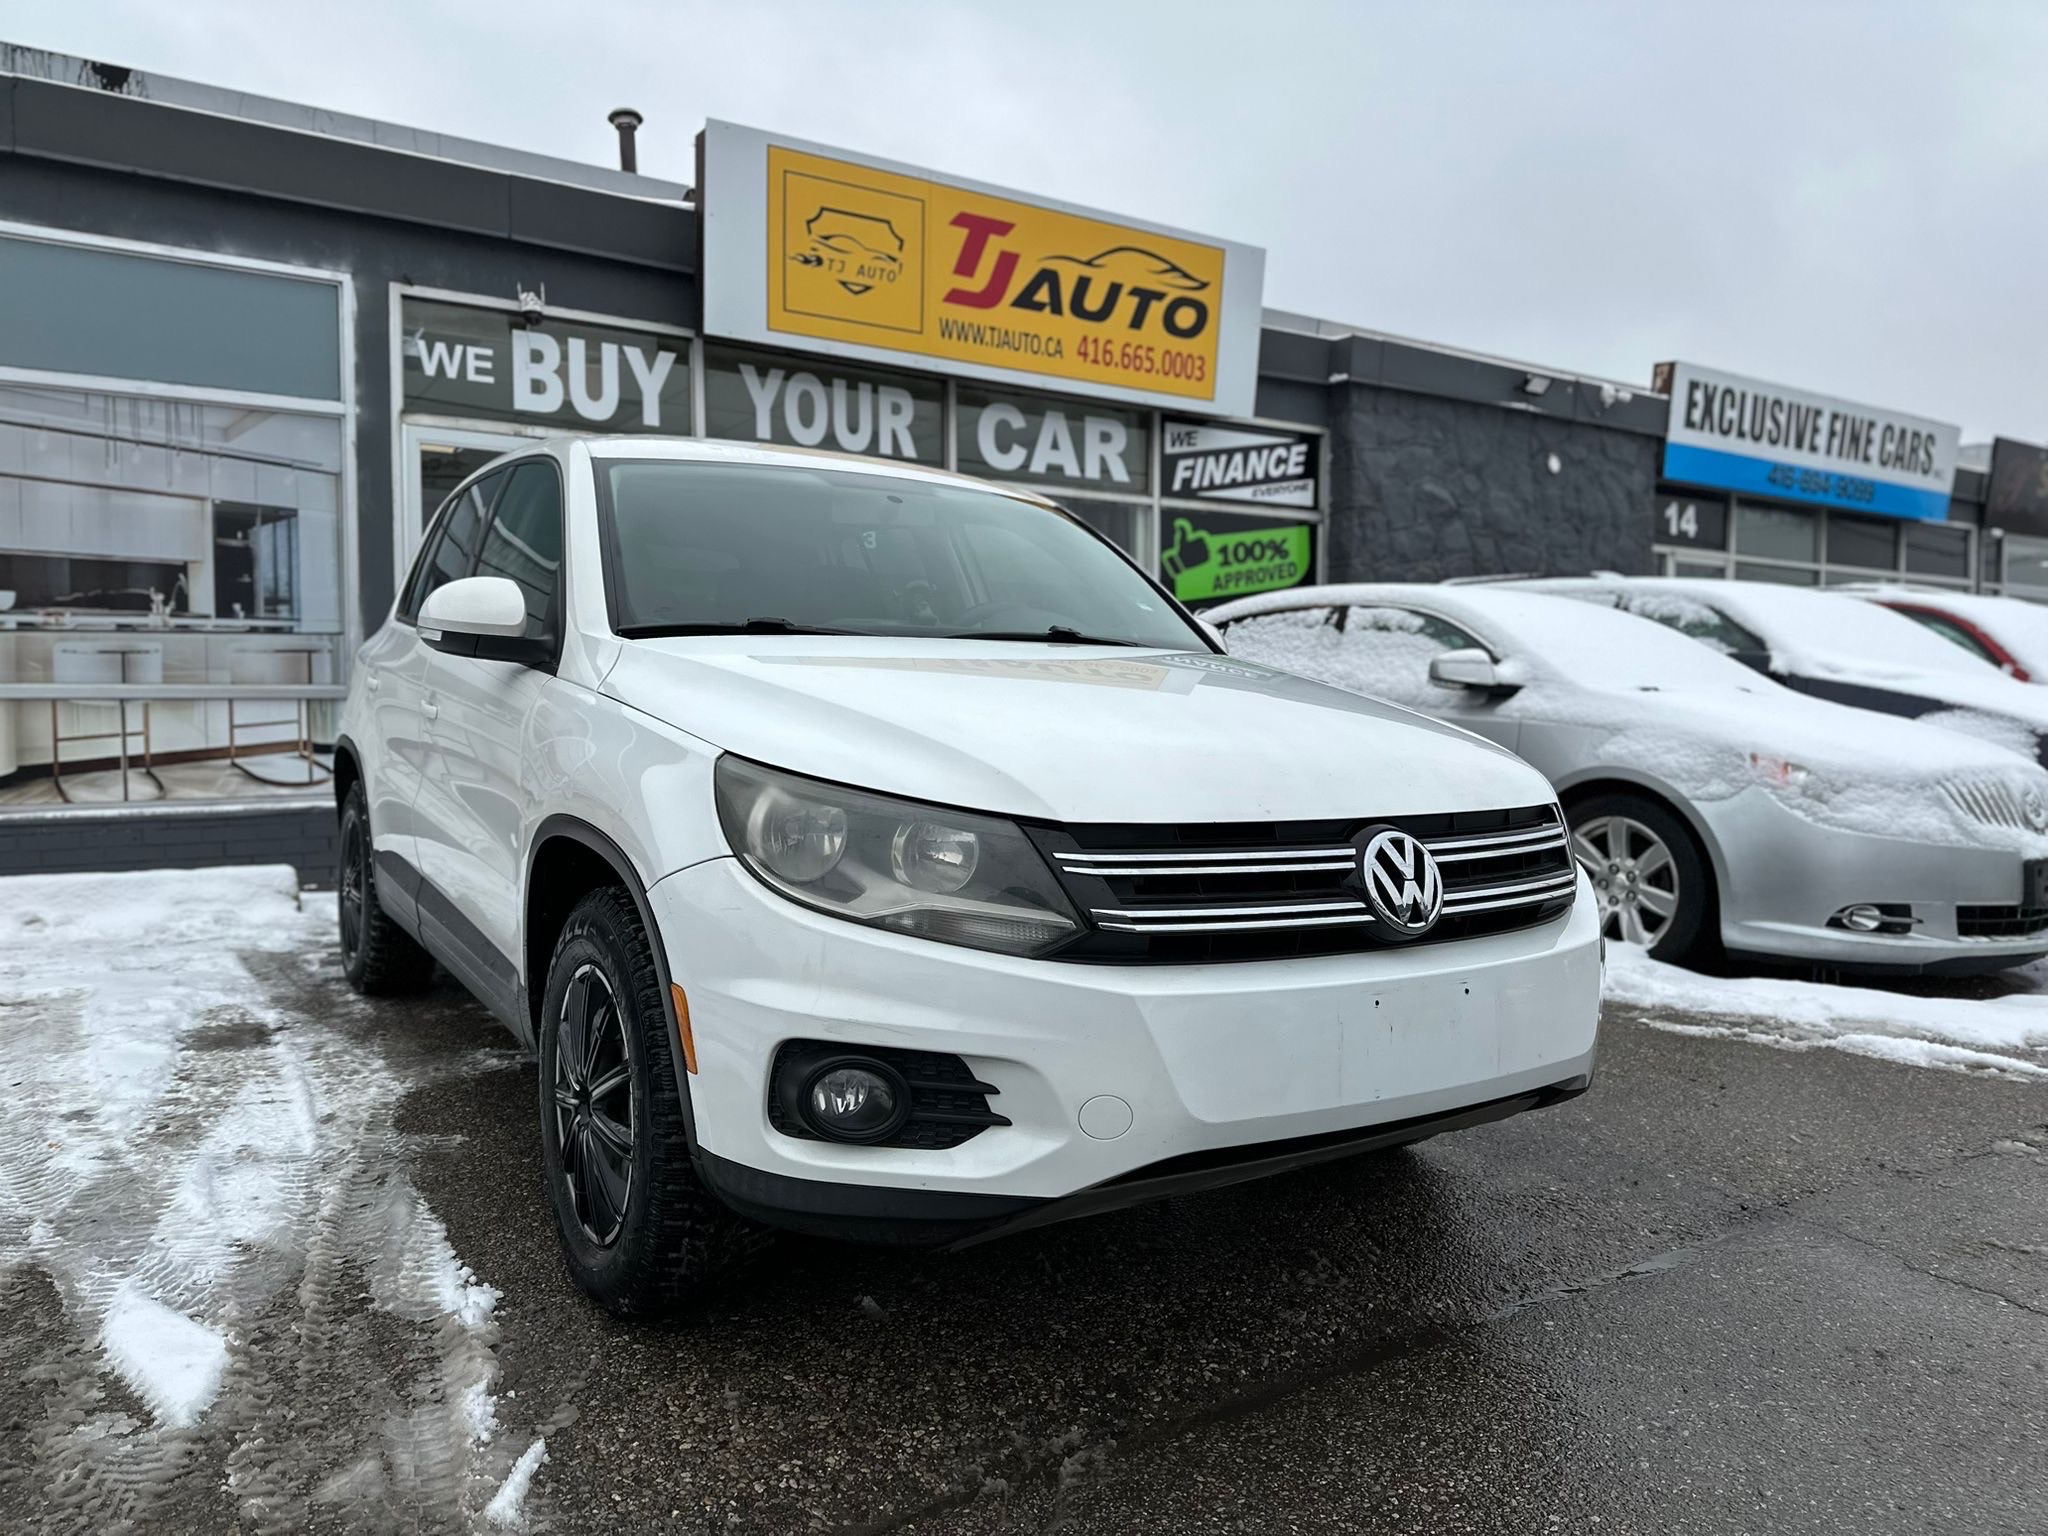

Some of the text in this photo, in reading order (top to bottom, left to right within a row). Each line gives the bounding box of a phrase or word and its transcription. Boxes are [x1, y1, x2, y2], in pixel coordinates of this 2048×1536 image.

[827, 257, 897, 283] TJ AUTO
[943, 211, 1209, 340] TJ AUTO
[938, 317, 1063, 359] WWW.TJAUTO.CA
[1076, 335, 1206, 382] 416.665.0003
[416, 329, 1130, 482] WE BUY YOUR CAR
[1169, 430, 1198, 448] WE
[1684, 380, 1937, 476] EXCLUSIVE FINE CARS
[1172, 443, 1308, 492] FINANCE
[1664, 501, 1699, 539] 14
[1217, 537, 1289, 568] 100%
[1212, 562, 1298, 593] APPROVED
